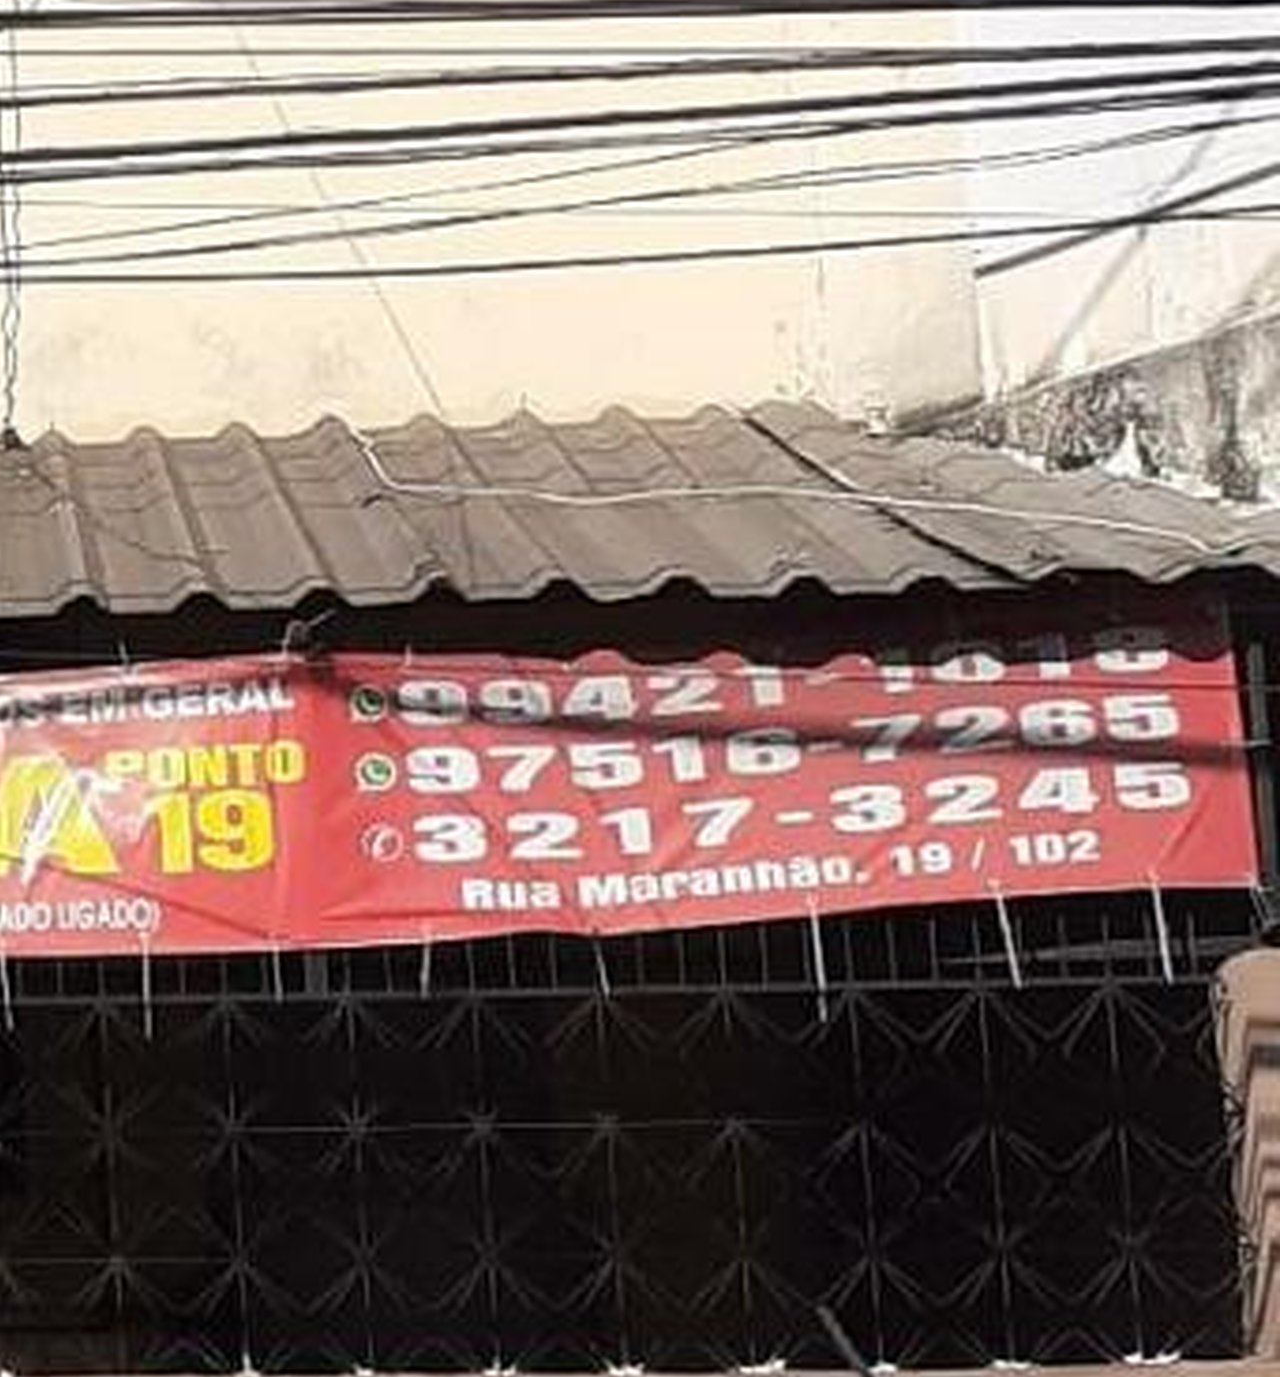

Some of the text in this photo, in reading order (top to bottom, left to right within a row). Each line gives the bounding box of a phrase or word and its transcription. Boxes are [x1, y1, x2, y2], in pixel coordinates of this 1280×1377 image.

[60, 686, 130, 724] EM
[137, 677, 297, 720] GERAL
[105, 739, 306, 788] PONTO
[405, 694, 1181, 796] 97516-7265
[142, 788, 275, 873] 19
[412, 762, 1192, 865] 3217-3245
[460, 878, 560, 910] Rua
[888, 843, 952, 876] 19
[969, 838, 987, 870] /
[1009, 830, 1101, 865] 102
[57, 896, 163, 931] LIGADO)
